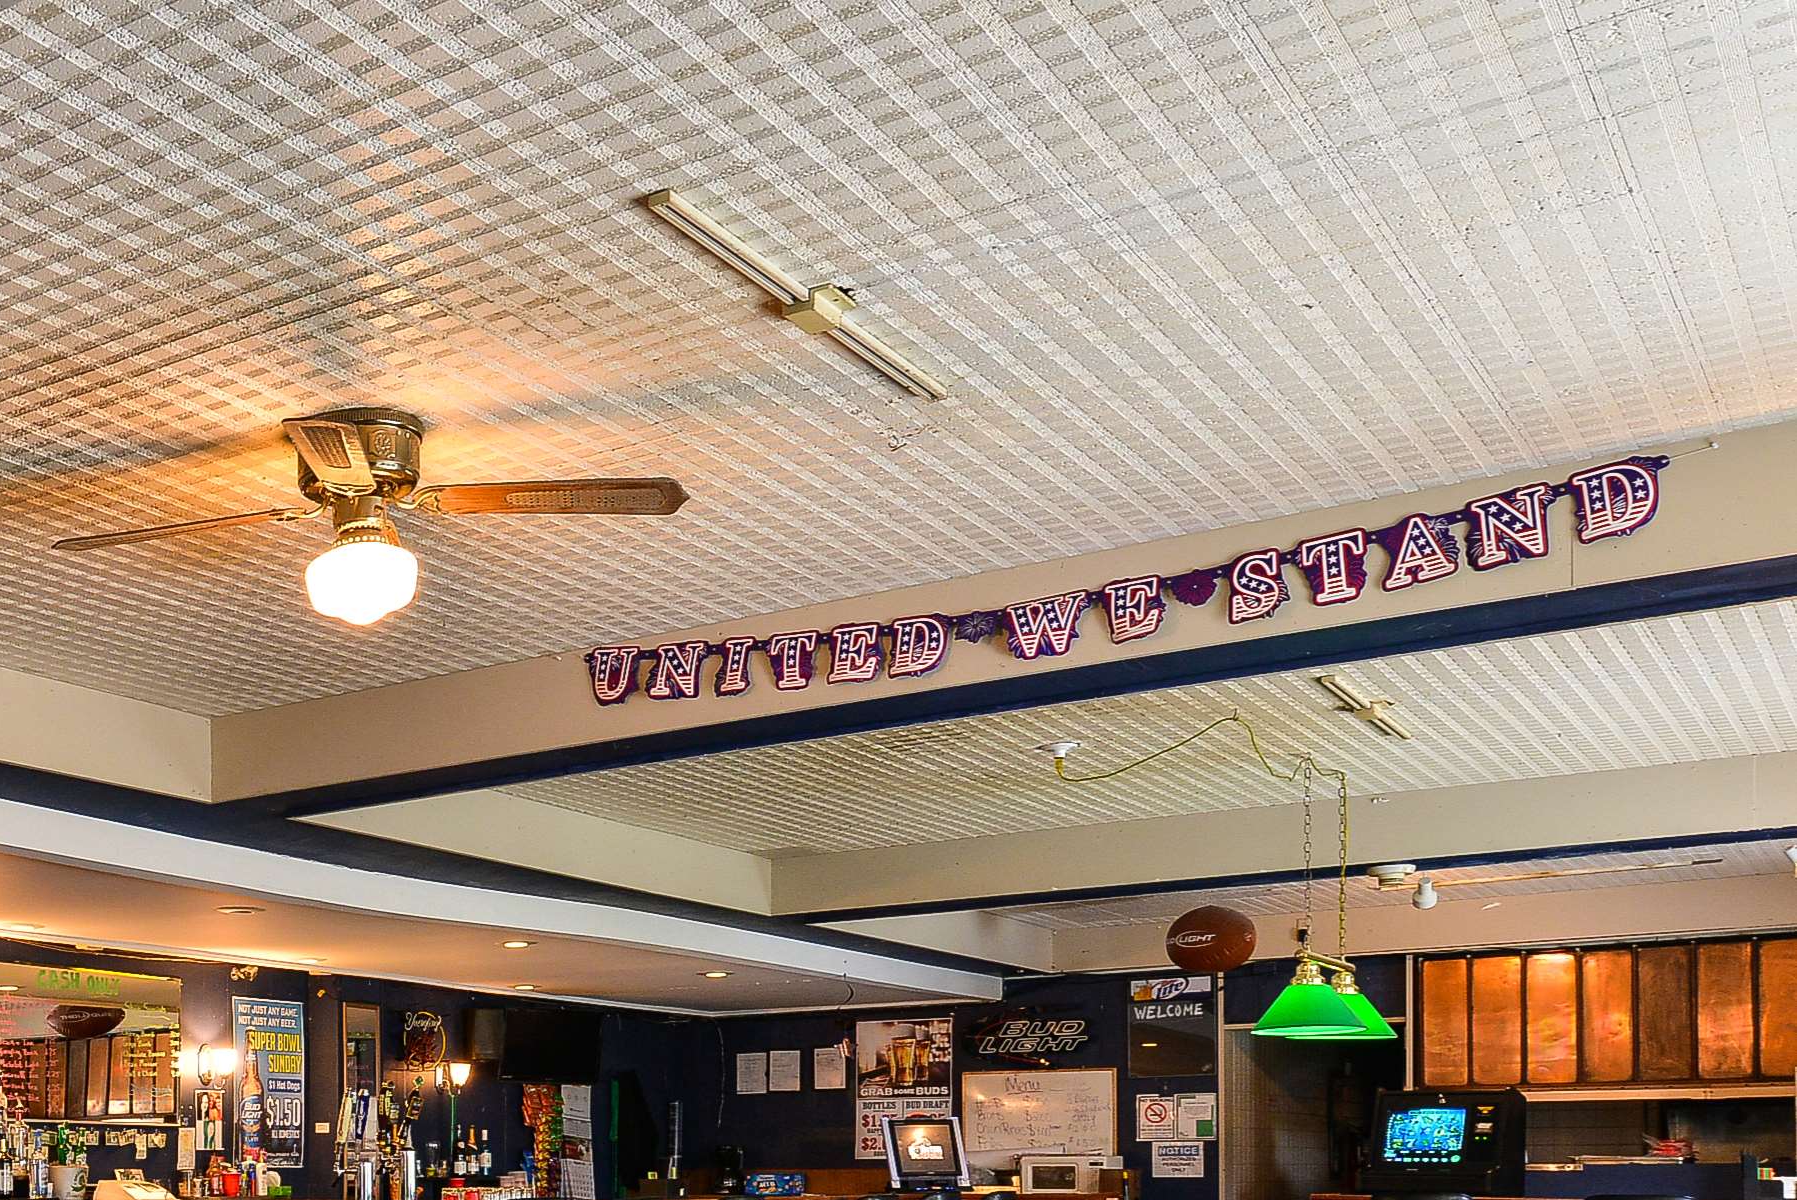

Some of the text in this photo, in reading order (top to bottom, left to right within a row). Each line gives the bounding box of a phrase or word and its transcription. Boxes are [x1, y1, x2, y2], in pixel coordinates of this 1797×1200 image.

[594, 464, 1656, 701] UNITED WE STAND
[1178, 934, 1217, 943] LIGHT
[36, 969, 122, 996] CASH ONLY
[238, 1004, 251, 1014] NOT
[251, 1005, 267, 1014] JUST
[267, 1006, 281, 1016] ANY
[1133, 1003, 1204, 1020] WELCOME
[238, 1015, 251, 1025] NOT
[251, 1016, 267, 1026] JUST
[267, 1018, 281, 1027] ANY
[998, 1020, 1085, 1037] BUD
[249, 1031, 302, 1052] SUPER BOWL
[978, 1035, 1089, 1054] LIGHT
[268, 1054, 302, 1073] SUNDAY
[268, 1080, 301, 1092] $1 Hot Dogs
[1004, 1075, 1043, 1092] Menu
[860, 1087, 893, 1096] GRAB
[915, 1086, 949, 1095] BUDS
[244, 1102, 261, 1111] BUD
[862, 1101, 897, 1110] BOTTLES
[905, 1101, 949, 1109] BUD DRAFT
[242, 1111, 263, 1119] LIGHT
[266, 1095, 301, 1129] $1.50
[1158, 1146, 1199, 1155] NOTICE
